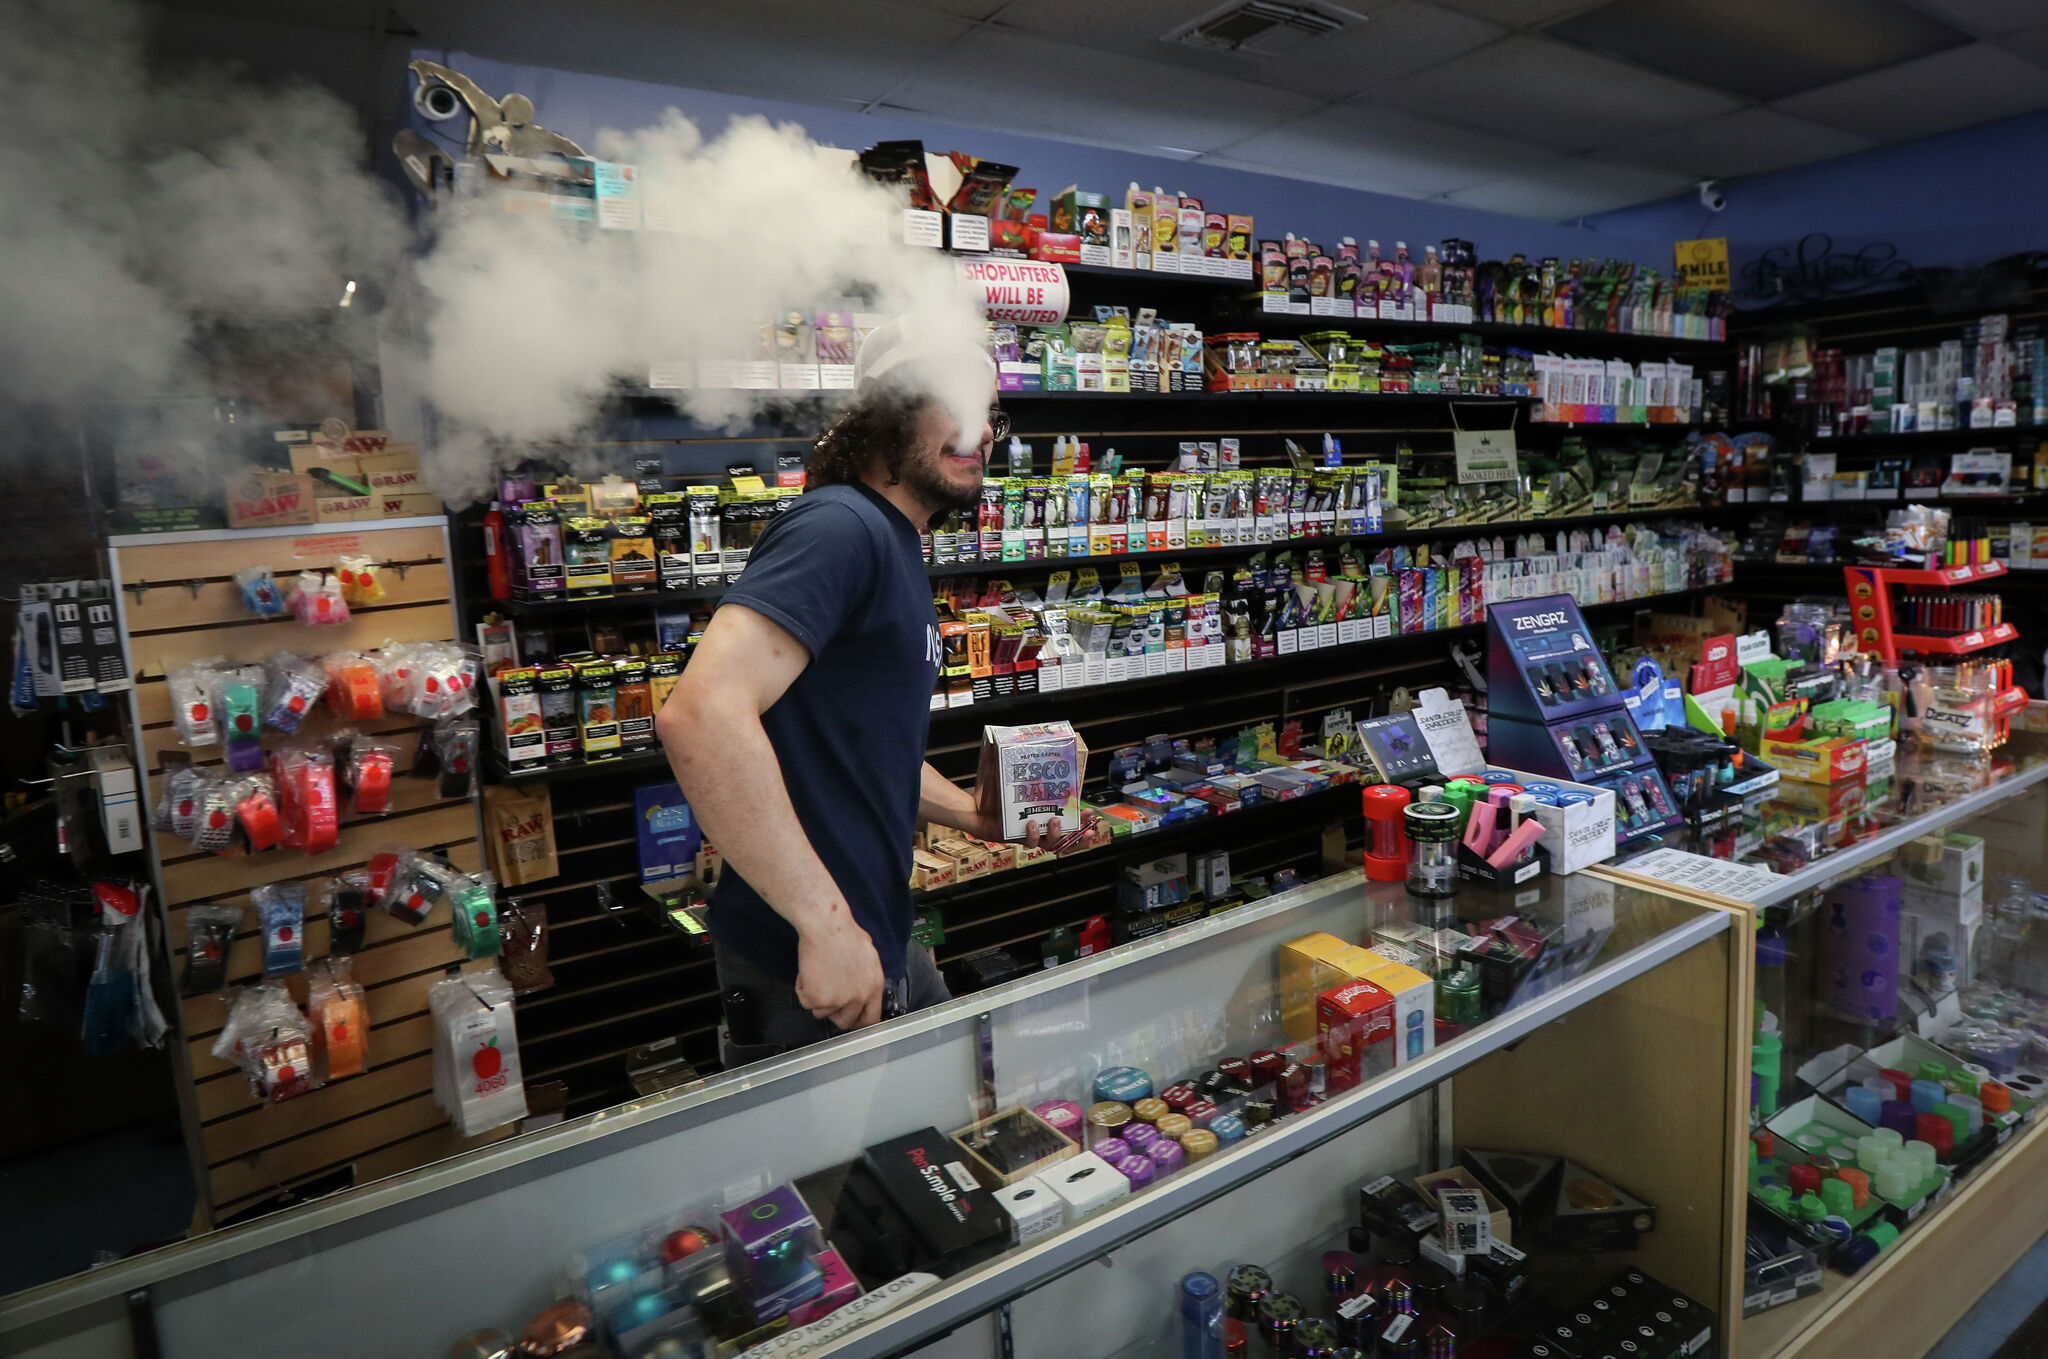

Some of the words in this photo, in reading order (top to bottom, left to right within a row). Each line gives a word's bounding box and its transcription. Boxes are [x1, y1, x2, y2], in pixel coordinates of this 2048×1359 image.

[964, 263, 1060, 283] SHOPLIFTERS
[1681, 261, 1726, 276] SMILE
[986, 286, 1021, 304] WILL
[1026, 288, 1044, 305] BE
[986, 308, 1058, 324] OSECUTED
[383, 472, 418, 486] RAW
[234, 493, 302, 520] RAW
[333, 498, 372, 512] RAW
[1122, 566, 1138, 574] 99¢
[1512, 611, 1569, 630] ZENGAZ
[1012, 760, 1070, 782] ESCO
[1012, 781, 1071, 804] BARS
[502, 812, 544, 844] RAW
[1092, 834, 1110, 846] RAW
[965, 859, 988, 875] RAW
[991, 855, 1014, 870] RAW
[933, 869, 954, 884] RAW
[1220, 1061, 1245, 1070] RAW
[1252, 1053, 1276, 1064] RAW
[1280, 1063, 1299, 1078] RAW
[475, 1075, 508, 1093] 4060
[775, 1329, 802, 1348] DO
[804, 1312, 842, 1334] NOT
[844, 1290, 887, 1315] LEAN
[887, 1276, 916, 1294] ON
